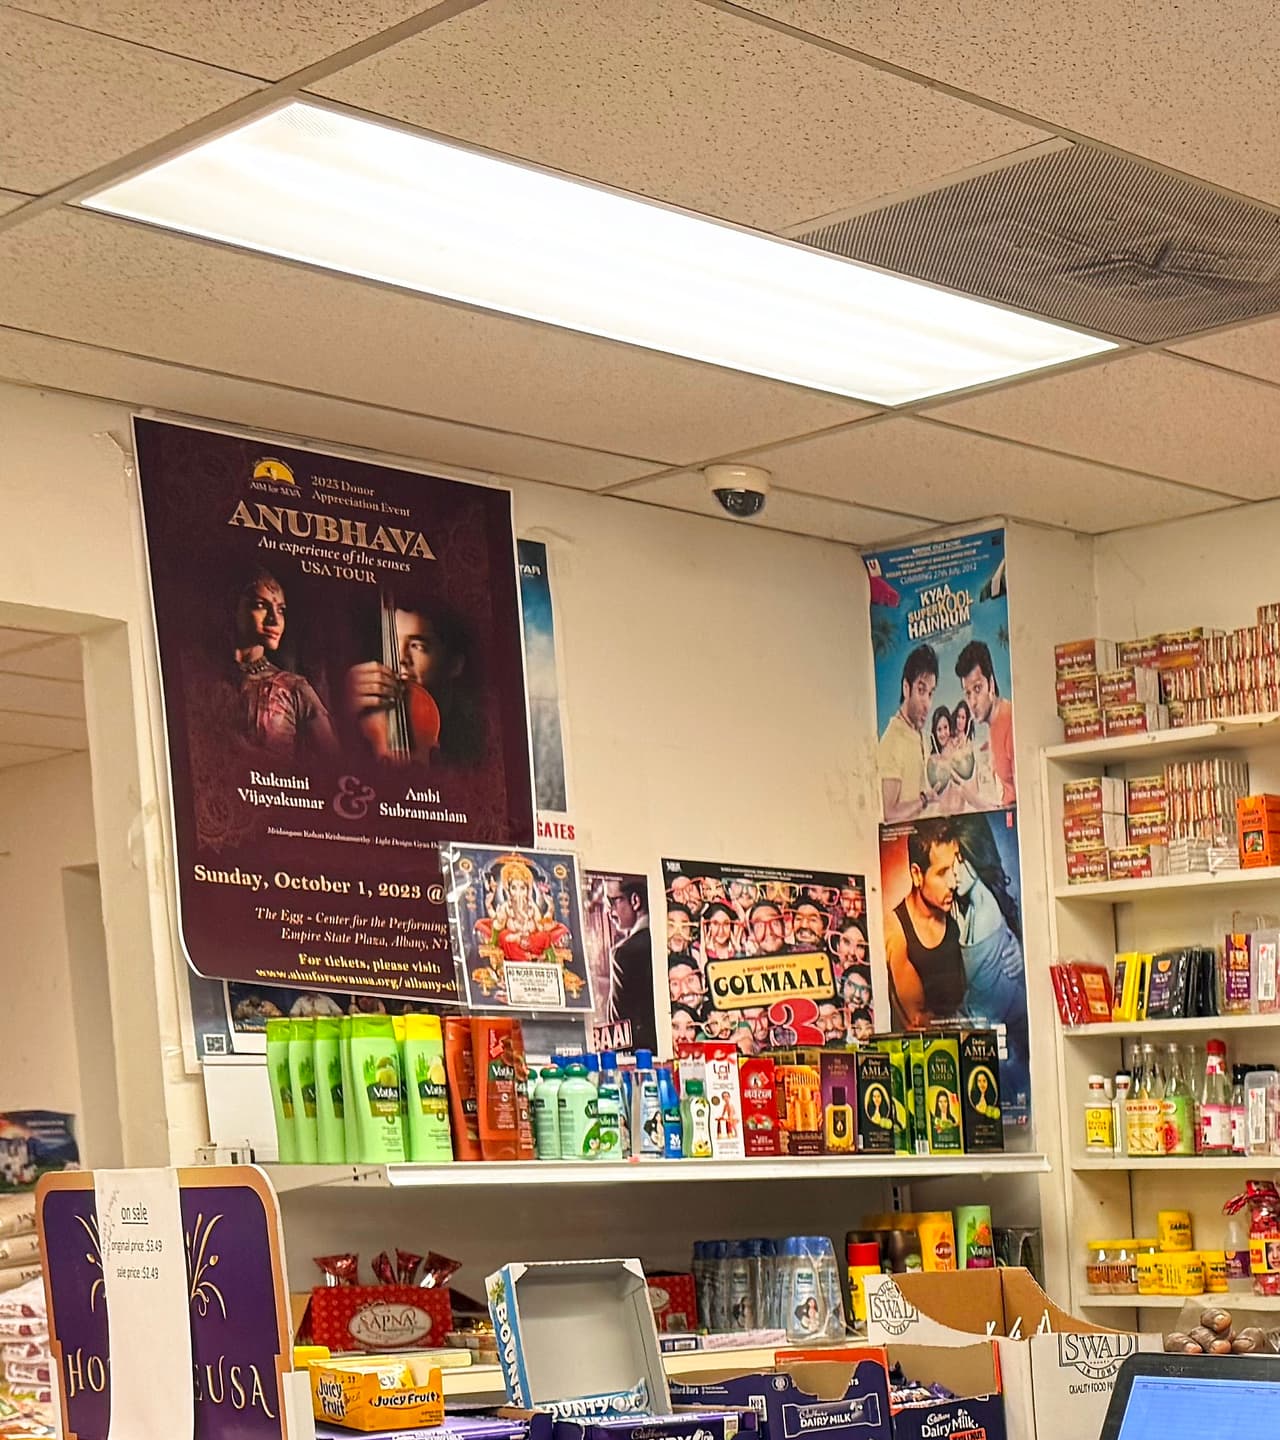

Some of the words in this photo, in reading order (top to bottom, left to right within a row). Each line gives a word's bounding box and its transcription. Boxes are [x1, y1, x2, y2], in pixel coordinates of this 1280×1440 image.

[341, 482, 375, 497] Donor
[312, 491, 379, 513] Appreciation
[381, 502, 411, 517] Event
[227, 500, 437, 560] ANUBHAVA
[258, 536, 276, 549] An
[279, 541, 340, 561] experience
[356, 553, 374, 566] the
[377, 559, 411, 572] senses
[301, 561, 332, 577] USA
[333, 566, 377, 584] TOUR
[921, 583, 951, 607] KYAA
[908, 604, 937, 623] SUPER
[937, 589, 973, 613] KOOL
[250, 771, 310, 790] Rukmini
[238, 787, 324, 810] Vijayakumar
[405, 788, 441, 803] Ambi
[379, 802, 467, 824] Subramaniam
[194, 864, 270, 891] Sunday,
[274, 871, 351, 894] October
[378, 882, 421, 900] 2023
[255, 906, 277, 920] The
[280, 909, 304, 925] Egg
[315, 912, 349, 926] Center
[349, 913, 368, 928] for
[370, 916, 386, 928] the
[389, 917, 447, 935] Performing
[281, 927, 321, 942] Empire
[324, 931, 351, 944] State
[355, 933, 389, 948] Plaza,
[392, 936, 429, 951] Albany,
[299, 953, 322, 966] For
[324, 954, 370, 971] tickets,
[372, 958, 409, 973] please
[768, 998, 825, 1046] 3
[965, 1045, 996, 1057] AMLA
[862, 1065, 890, 1077] AMLA
[930, 1065, 954, 1074] AMLA
[121, 1207, 132, 1220] on
[132, 1203, 148, 1220] sale
[111, 1240, 130, 1254] original
[130, 1240, 144, 1254] price
[127, 1267, 141, 1281] price
[356, 1312, 416, 1334] SAPNA
[1065, 1333, 1133, 1362] SWAD
[318, 1379, 342, 1400] Juicy
[1069, 1383, 1091, 1394] QUALITY
[322, 1398, 345, 1417] Fruit
[374, 1394, 405, 1407] Juicy
[406, 1392, 437, 1405] Fruit
[800, 1415, 830, 1428] DAIRY
[830, 1412, 851, 1424] MILK
[921, 1422, 952, 1438] Dairy
